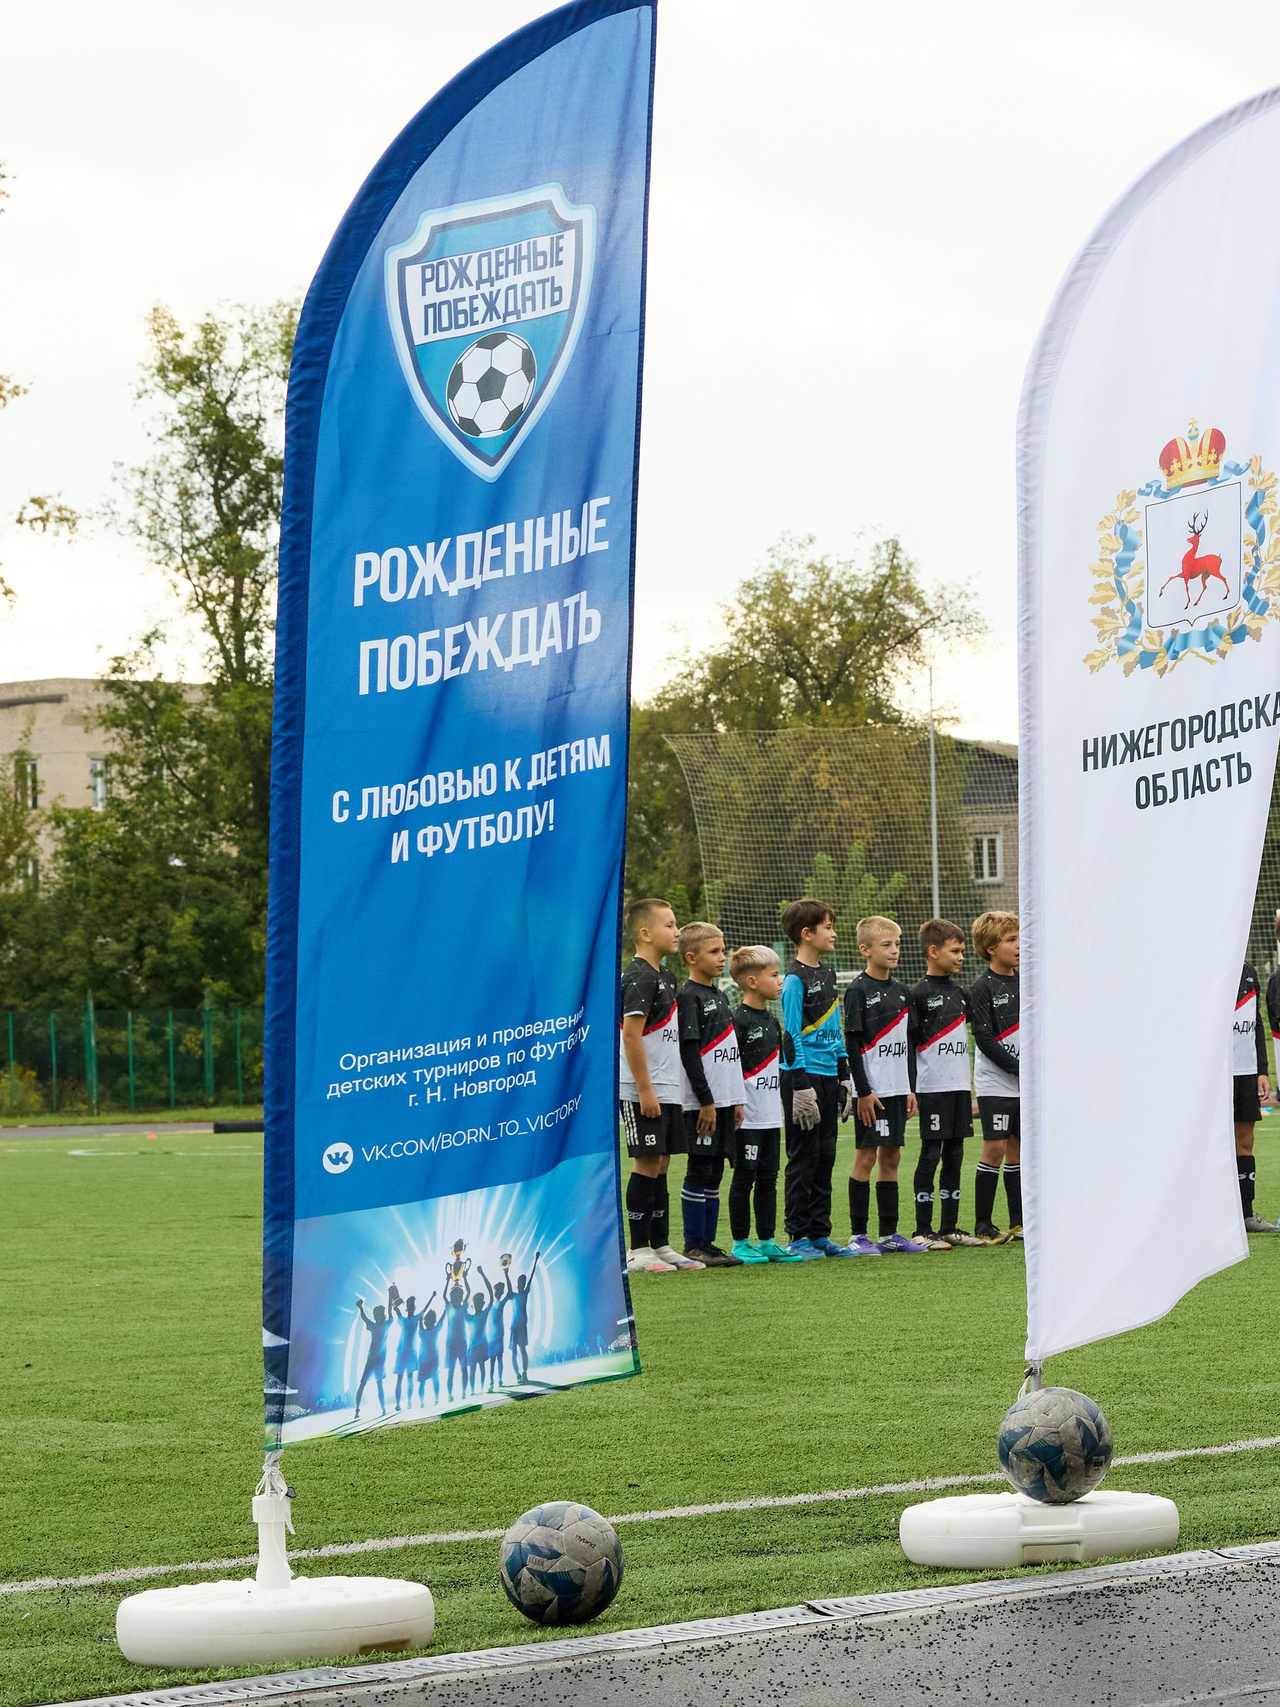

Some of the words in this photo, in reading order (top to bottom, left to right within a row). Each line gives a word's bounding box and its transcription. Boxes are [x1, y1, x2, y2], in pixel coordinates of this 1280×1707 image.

[420, 234, 565, 297] РОЖДЕННЫЕ
[423, 275, 563, 337] ПОБЕЖДАТЬ
[353, 495, 611, 608] РОЖДЕННЫЕ
[358, 590, 602, 696] ПОБЕЖДАТЬ
[331, 789, 350, 824] С
[356, 762, 498, 822] ЛЮБОВЬЮ
[504, 757, 523, 792] К
[526, 733, 612, 791] ДЕТЯМ
[1135, 750, 1253, 811] ОБЛАСТЬ
[390, 828, 410, 864] И
[416, 798, 556, 858] ФУТБОЛУ!
[326, 1070, 407, 1099] детских
[412, 1056, 501, 1086] турниров
[506, 1049, 526, 1066] по
[529, 1024, 591, 1065] футболу
[339, 1036, 471, 1073] Организация
[476, 1032, 488, 1048] и
[408, 1093, 419, 1107] г.
[426, 1085, 447, 1104] Н.
[453, 1069, 537, 1099] Новгород
[360, 1094, 582, 1163] VK.COM/BORN_TO_VICTORY
[644, 1134, 657, 1146] 93
[744, 1144, 759, 1161] 39
[930, 1113, 940, 1131] 3
